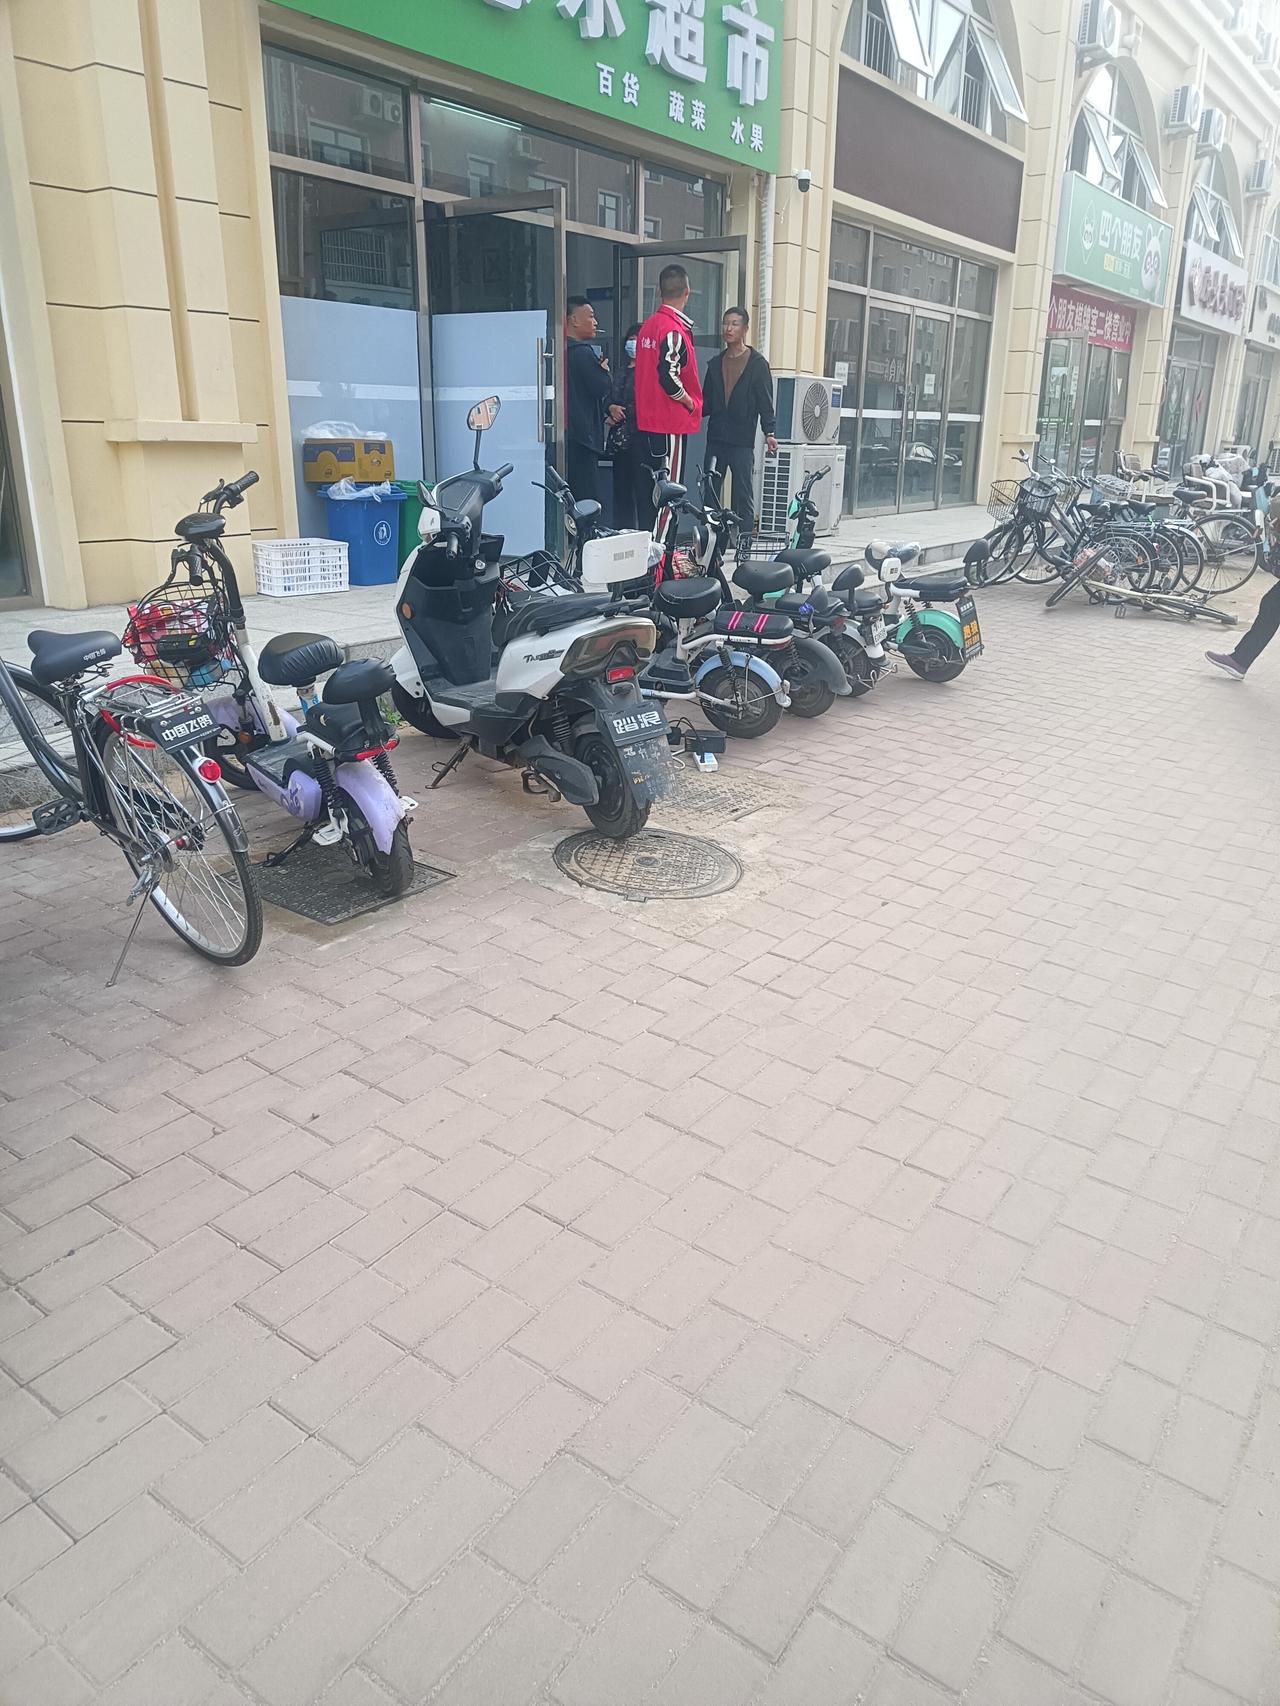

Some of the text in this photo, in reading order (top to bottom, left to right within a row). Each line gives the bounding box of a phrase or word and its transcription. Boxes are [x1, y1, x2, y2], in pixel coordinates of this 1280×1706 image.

[484, 0, 775, 107] 超市
[596, 62, 764, 153] 百货 蔬菜 水果
[1099, 211, 1143, 261] 四个朋友
[161, 714, 214, 741] 中国飞鸽
[612, 711, 662, 734] 踏浪
